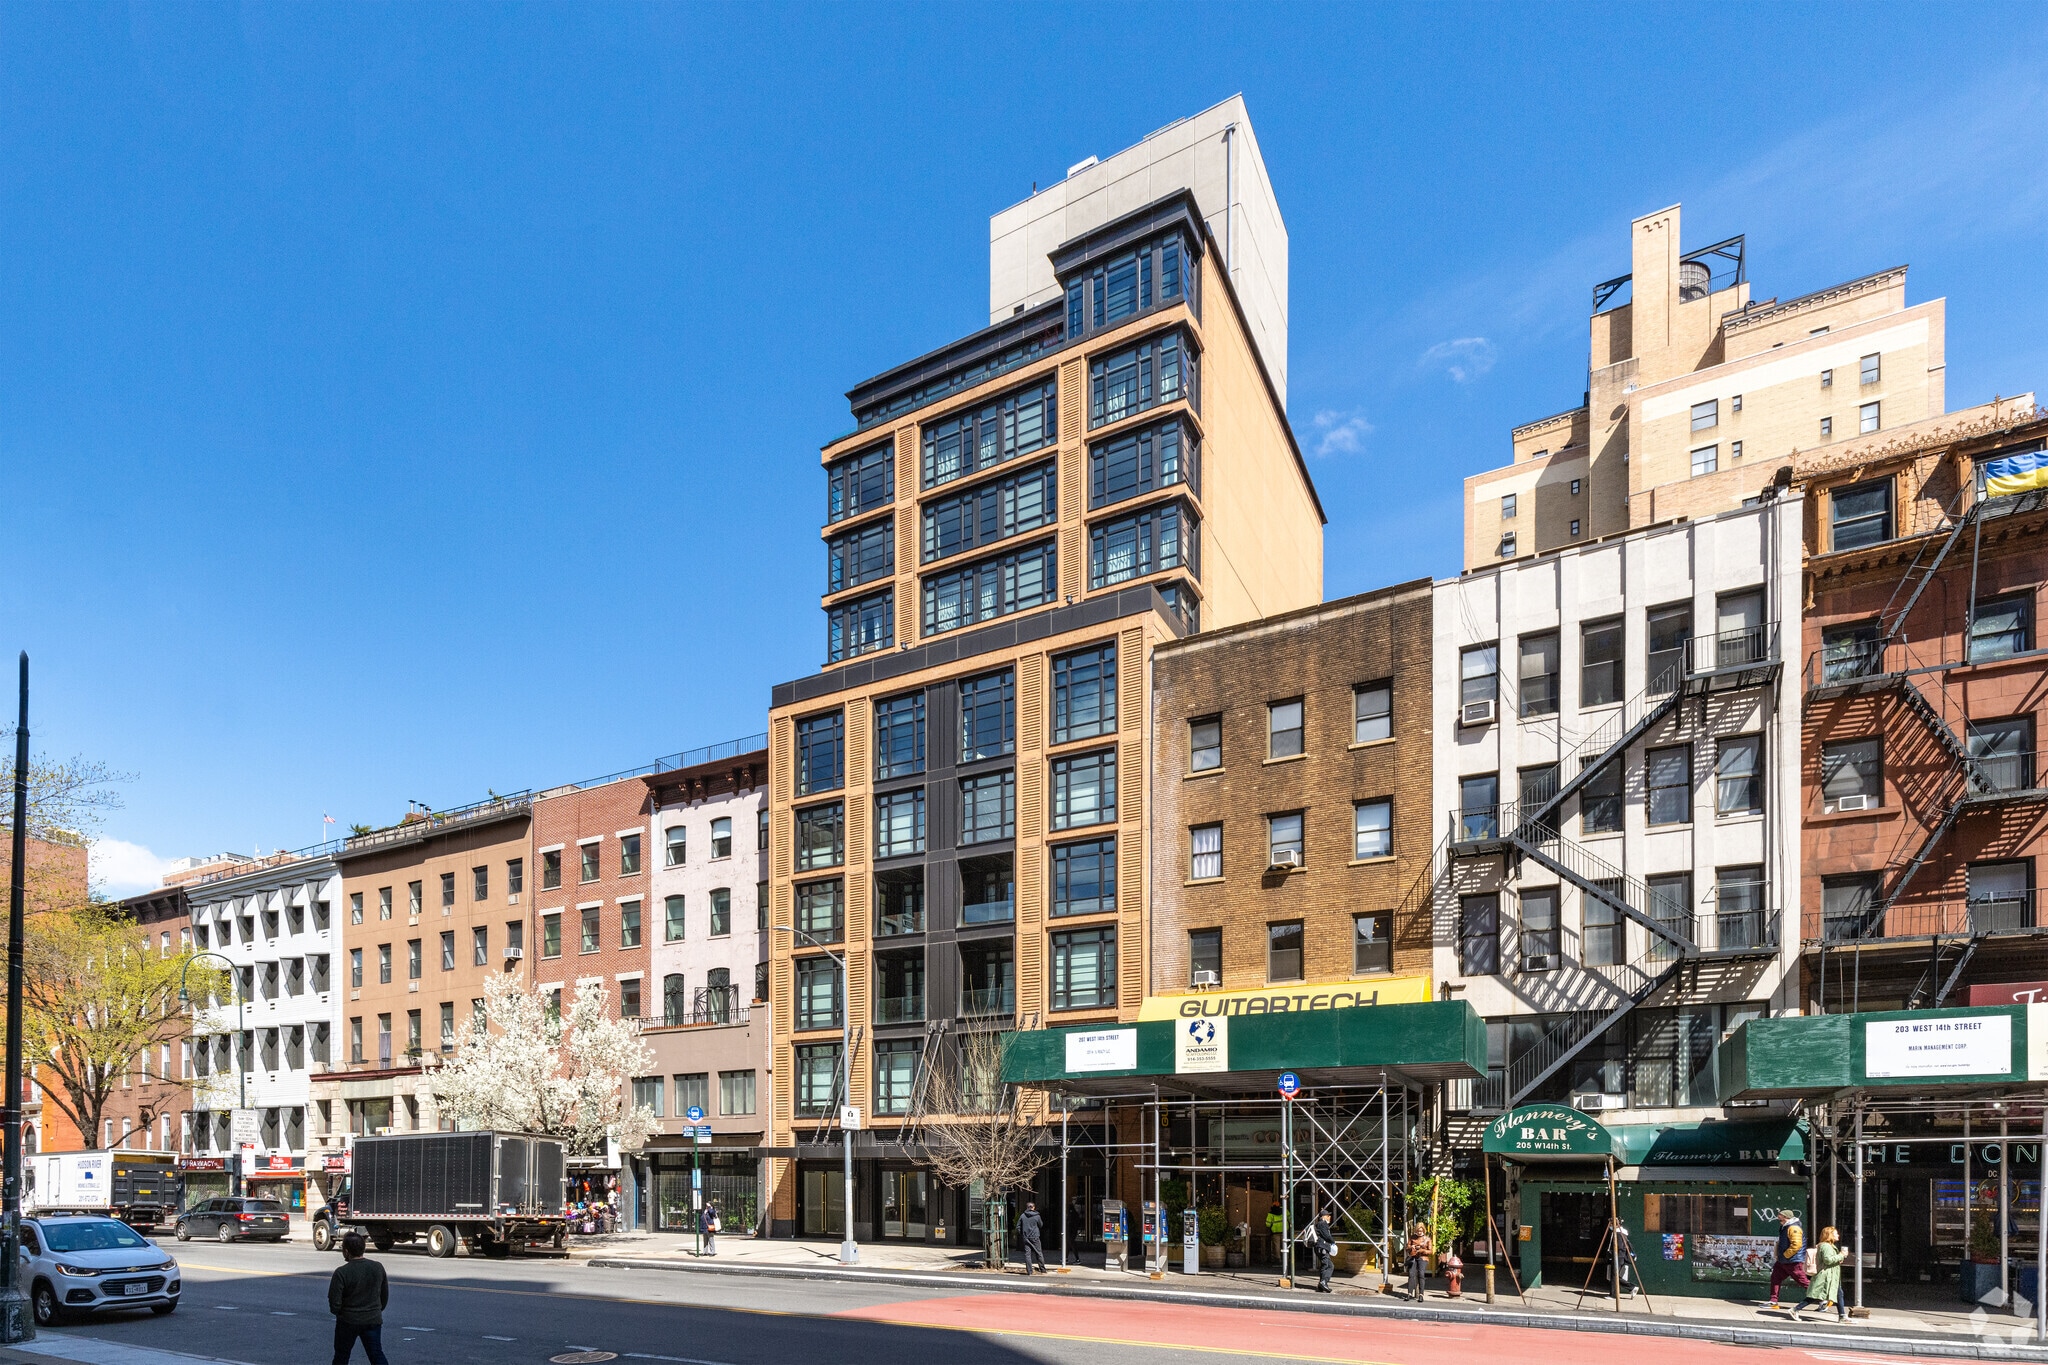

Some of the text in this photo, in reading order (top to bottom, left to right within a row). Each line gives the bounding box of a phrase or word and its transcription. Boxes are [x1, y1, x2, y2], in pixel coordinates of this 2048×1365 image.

[1179, 990, 1379, 1017] GUITARTECH
[1954, 1022, 1982, 1030] STREET
[1493, 1110, 1598, 1140] Flannery's
[1520, 1127, 1567, 1140] BAR
[1653, 1149, 1779, 1163] Flannery's BAR
